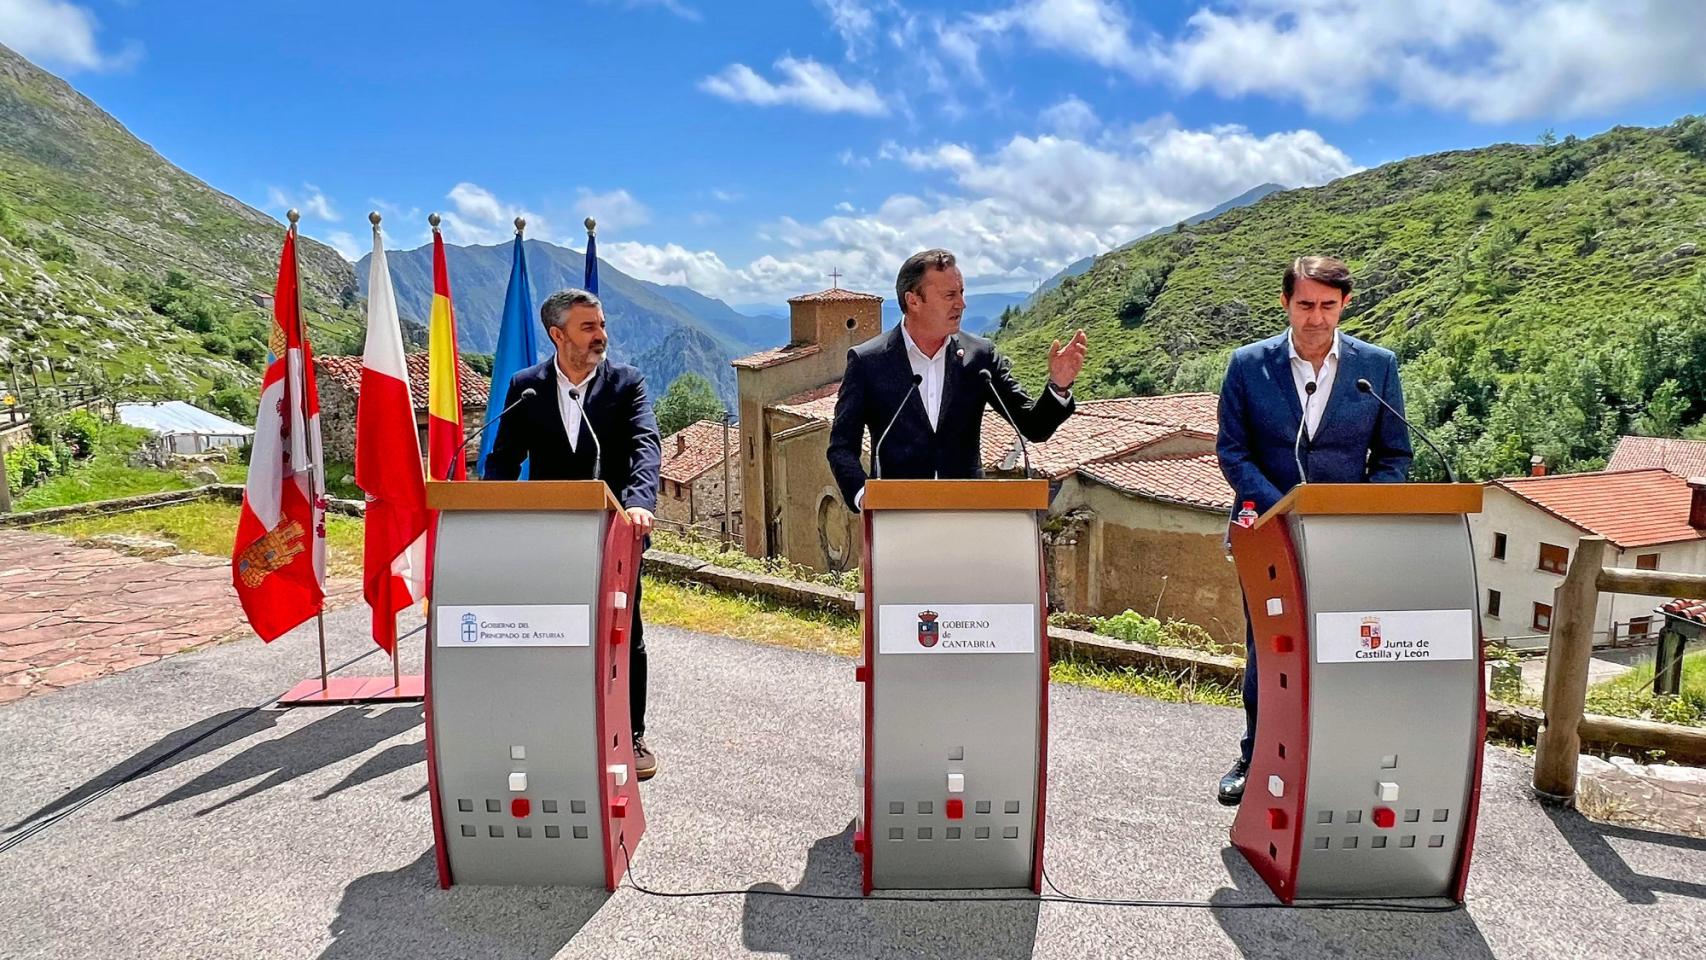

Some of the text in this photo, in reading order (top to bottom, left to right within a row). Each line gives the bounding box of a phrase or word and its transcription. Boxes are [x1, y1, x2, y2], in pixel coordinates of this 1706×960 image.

[942, 620, 990, 629] GOBIERNO
[533, 631, 565, 639] ASTURIAS
[942, 631, 951, 639] de
[942, 640, 996, 648] CANTABRIA
[1384, 639, 1429, 649] Junta de
[1355, 649, 1430, 660] Castilla y León
